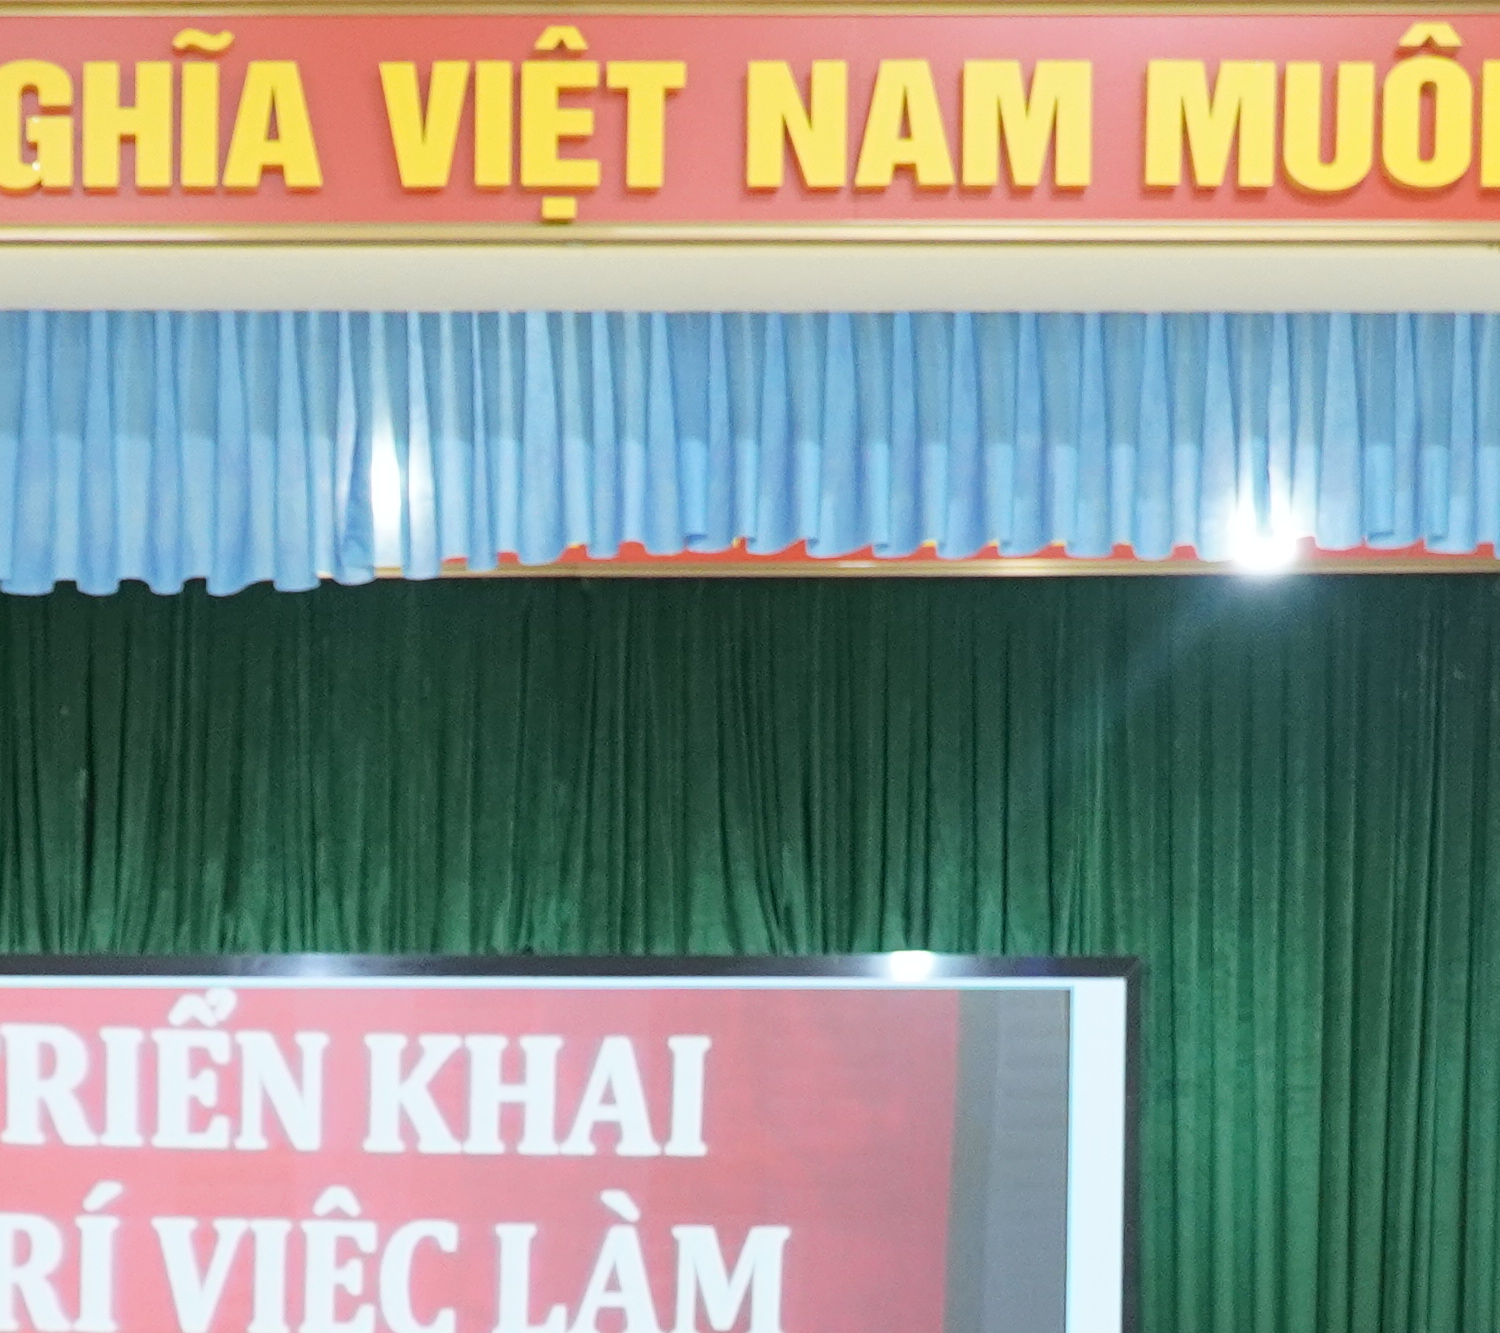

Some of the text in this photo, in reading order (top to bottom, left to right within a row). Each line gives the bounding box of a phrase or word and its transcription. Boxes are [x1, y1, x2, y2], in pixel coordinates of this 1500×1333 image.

[378, 24, 688, 220] VIỆT
[745, 58, 1093, 190] NAM
[362, 1033, 713, 1158] KHAI
